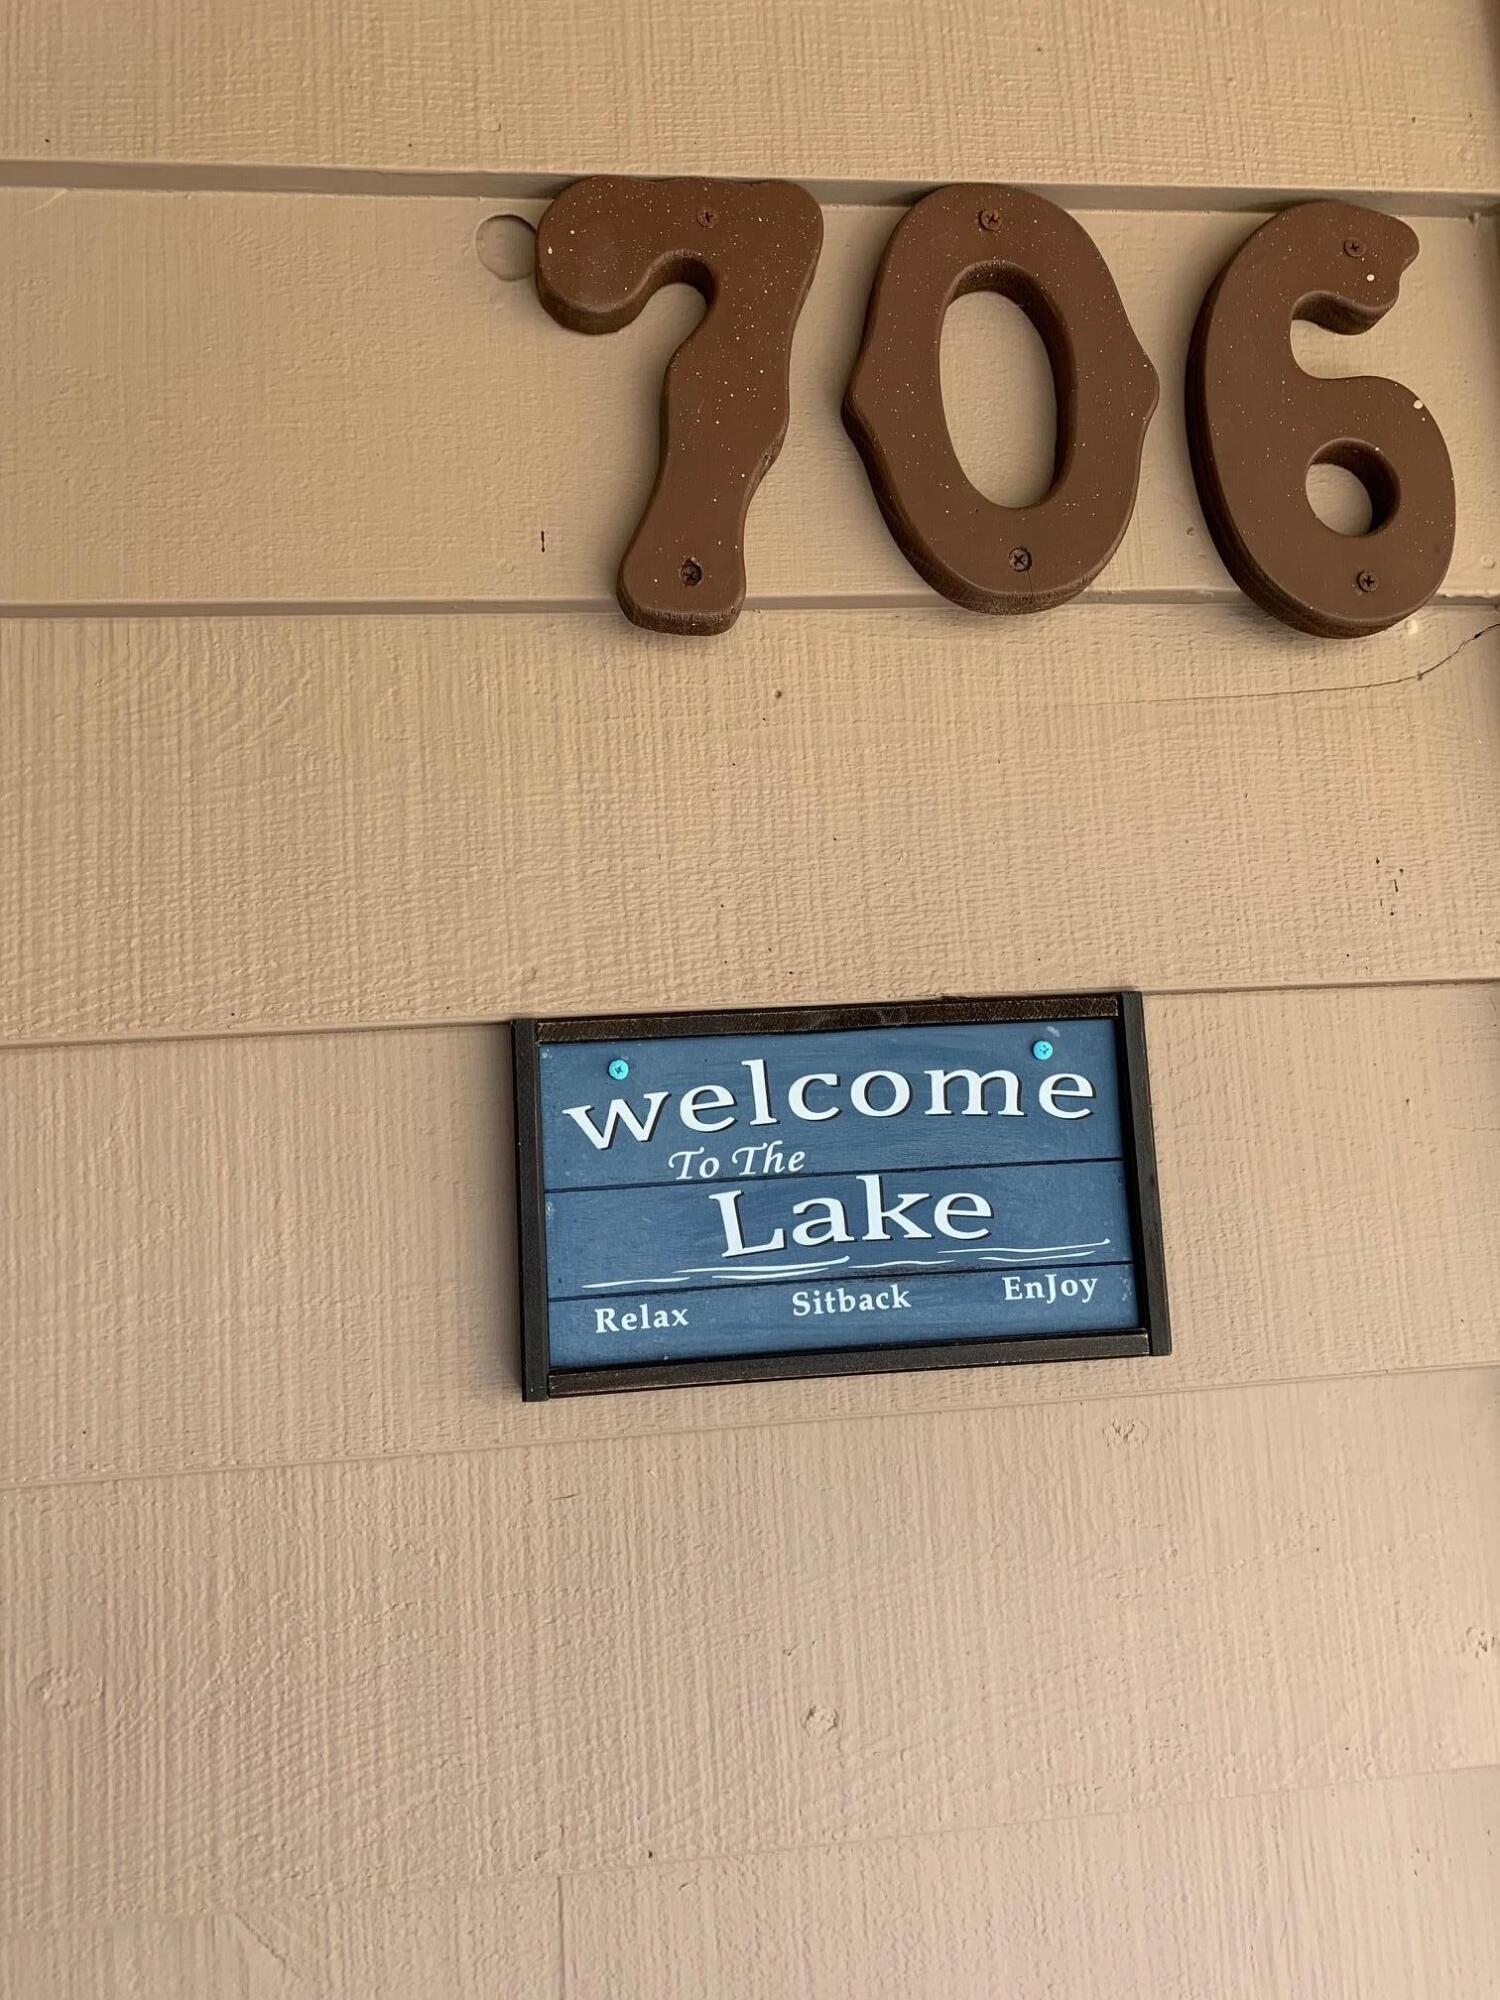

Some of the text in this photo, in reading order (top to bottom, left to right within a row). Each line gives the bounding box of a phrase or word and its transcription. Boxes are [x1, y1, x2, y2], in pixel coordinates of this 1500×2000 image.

[534, 174, 1456, 638] 706
[562, 1058, 1096, 1151] welcome
[668, 1140, 806, 1182] To The
[708, 1174, 993, 1259] Lake
[594, 1304, 690, 1334] Relax
[791, 1283, 912, 1317] Sitback
